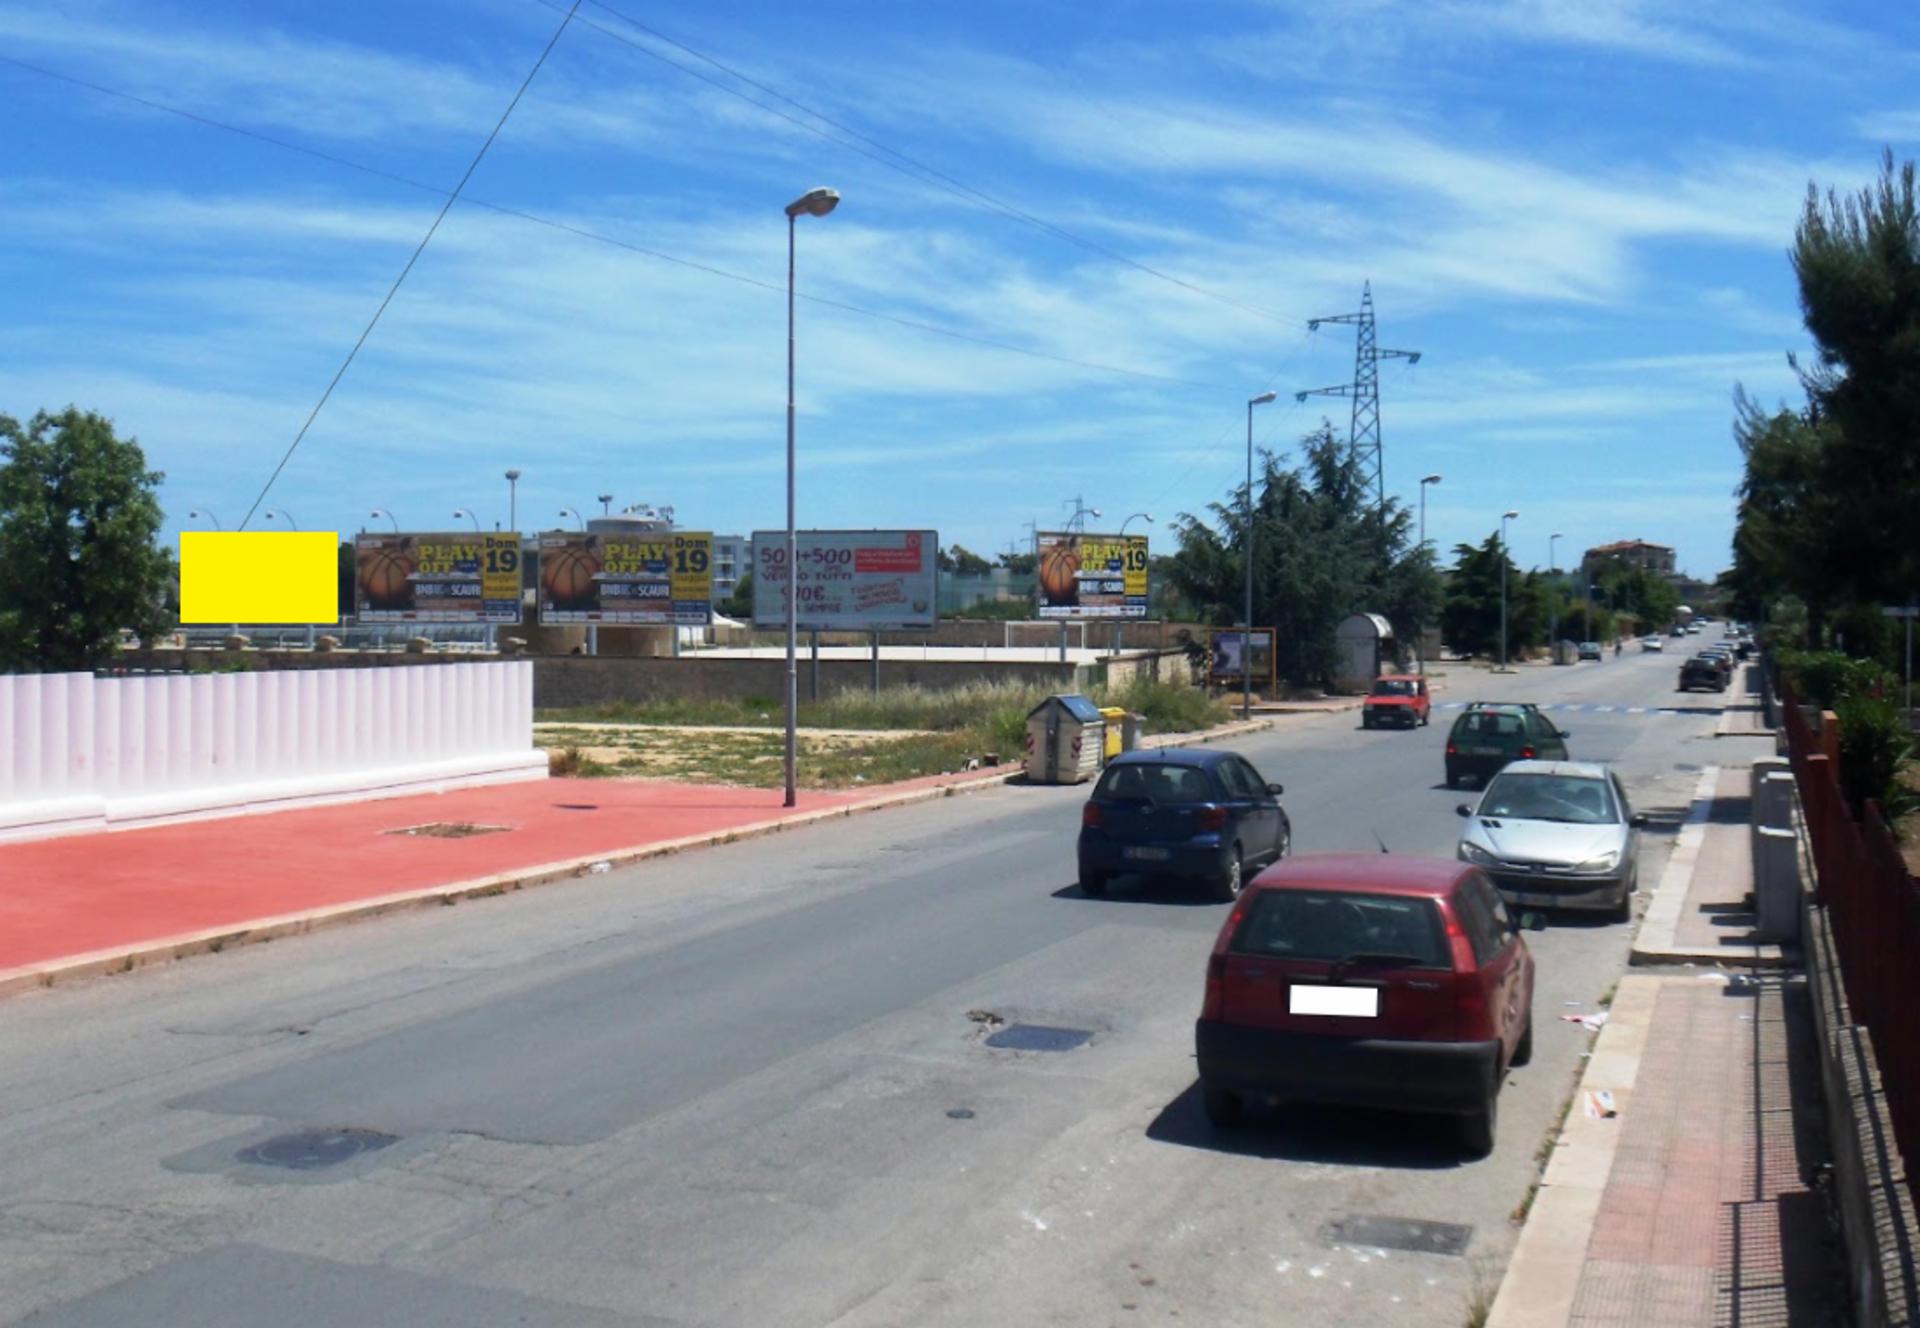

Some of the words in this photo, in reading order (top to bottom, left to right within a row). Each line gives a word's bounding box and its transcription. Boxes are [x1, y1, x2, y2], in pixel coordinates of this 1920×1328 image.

[486, 537, 517, 549] Dom
[675, 537, 708, 549] Dom
[419, 545, 477, 560] PLAY
[604, 544, 666, 560] PLAY
[761, 547, 851, 565] 50+500
[1082, 543, 1121, 560] PLAY
[419, 561, 454, 574] OFF
[486, 550, 517, 573] 19
[604, 561, 641, 574] OFF
[675, 549, 708, 573] 19
[1127, 549, 1146, 571] 19
